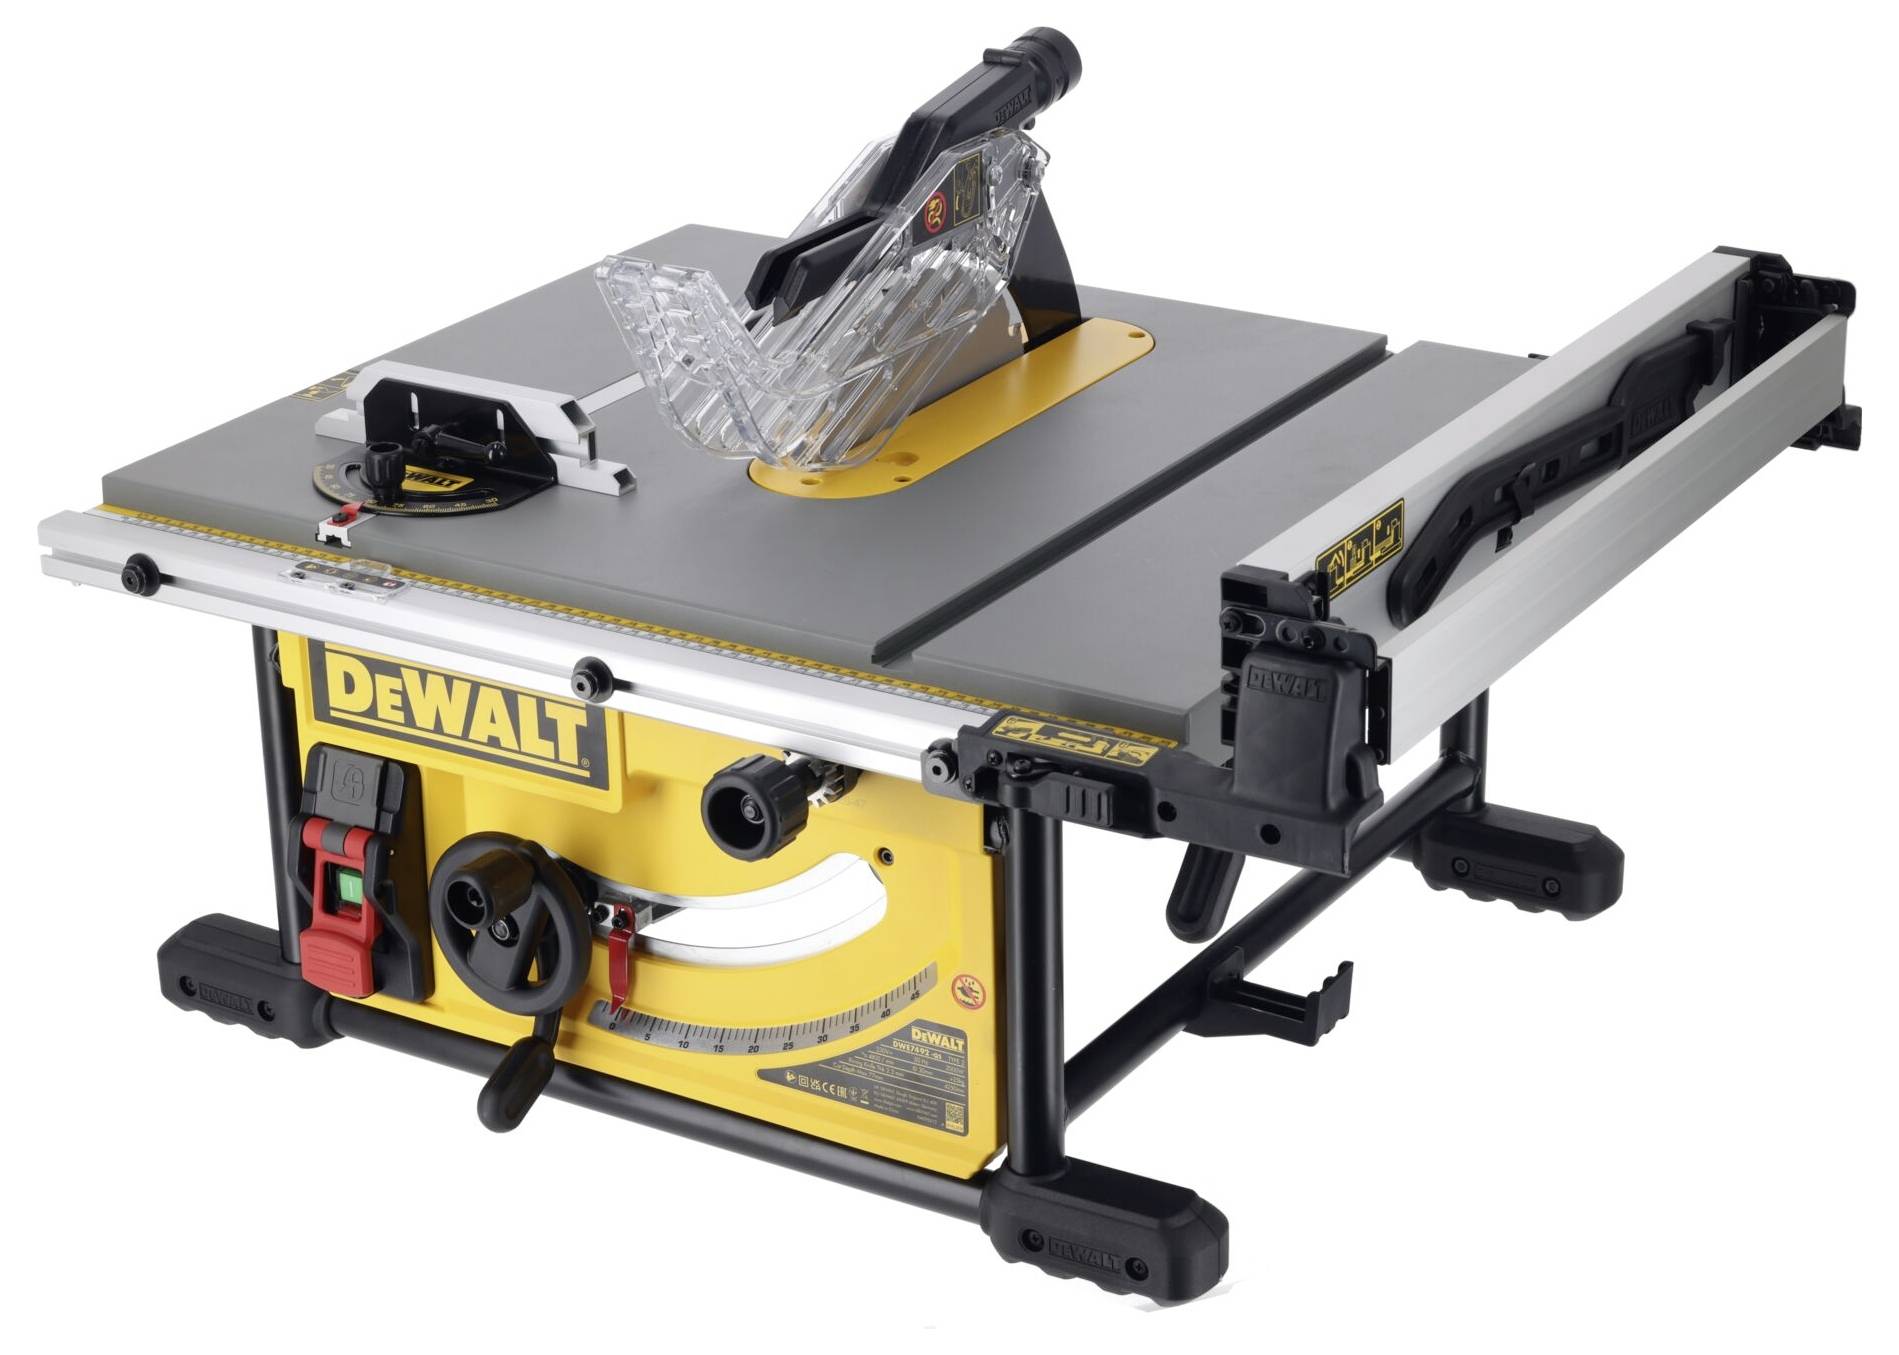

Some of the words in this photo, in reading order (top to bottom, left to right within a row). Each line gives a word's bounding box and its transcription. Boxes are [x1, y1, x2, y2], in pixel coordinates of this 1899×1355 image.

[406, 472, 462, 488] WALT
[609, 1022, 616, 1030] 0
[644, 1033, 651, 1041] 5
[678, 1040, 689, 1049] 10
[713, 1044, 725, 1053] 15
[747, 1045, 760, 1054] 20
[782, 1041, 794, 1051] 25
[816, 1034, 828, 1044] 30
[849, 1023, 860, 1034] 35
[880, 1008, 891, 1019] 40
[910, 990, 920, 1001] 45
[892, 1041, 930, 1057] DWE7492
